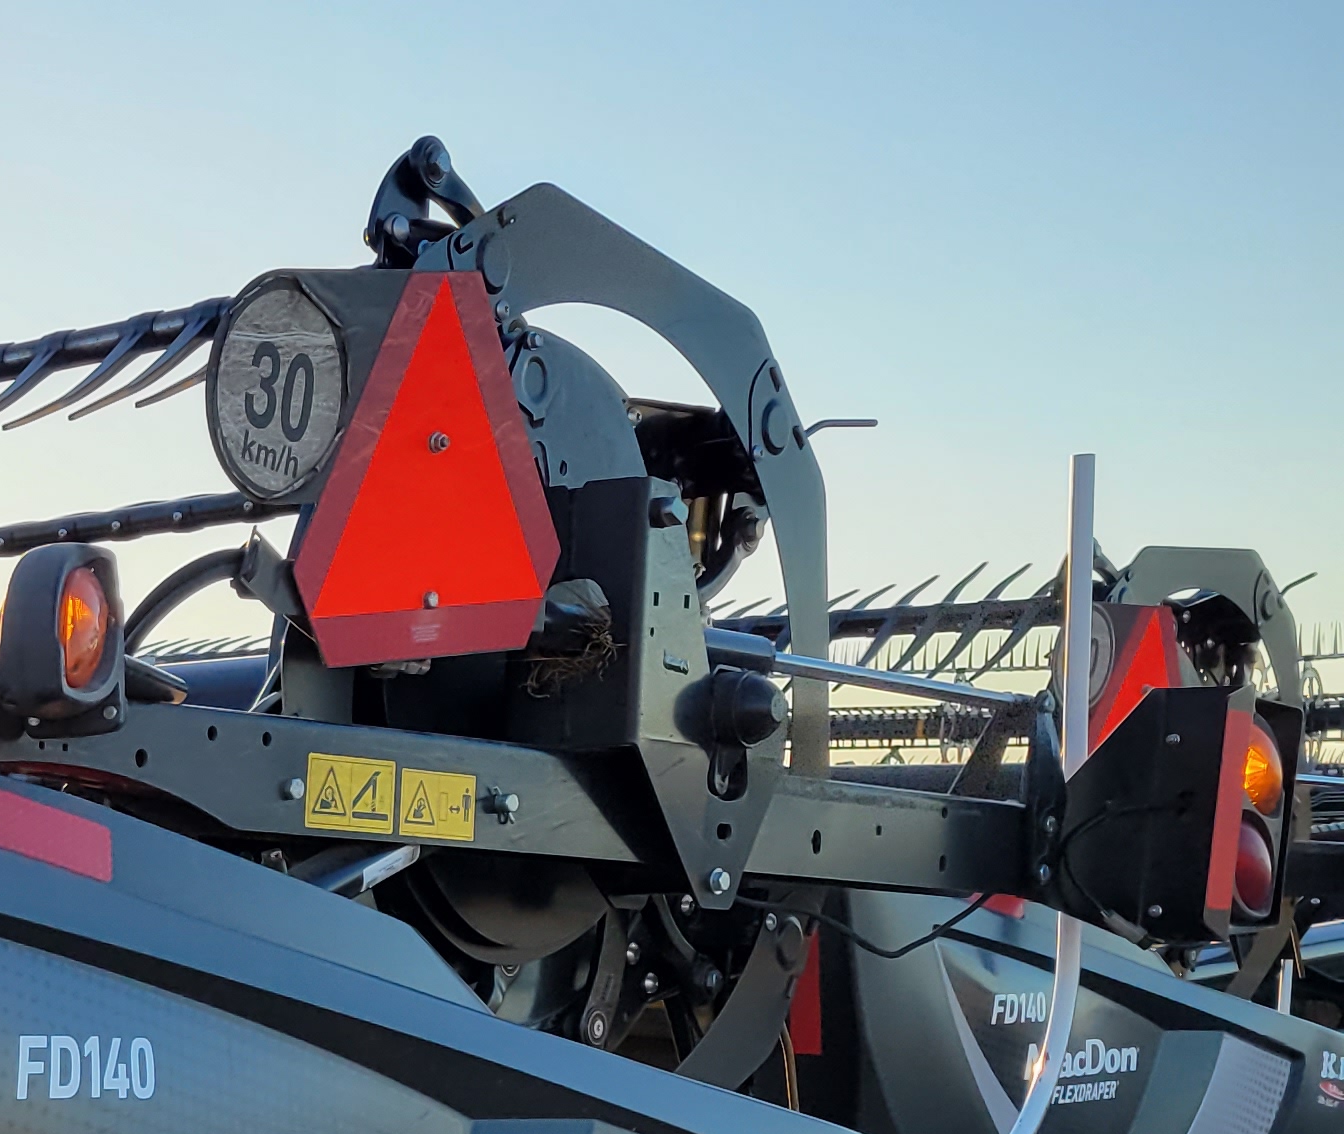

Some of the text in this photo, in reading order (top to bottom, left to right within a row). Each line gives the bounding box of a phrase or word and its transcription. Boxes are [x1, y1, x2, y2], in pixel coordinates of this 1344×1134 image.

[244, 340, 315, 443] 30
[240, 430, 300, 478] km/h
[991, 992, 1046, 1025] FD140
[16, 1034, 156, 1100] FD140
[1051, 1082, 1117, 1104] FLEXDRAPER
